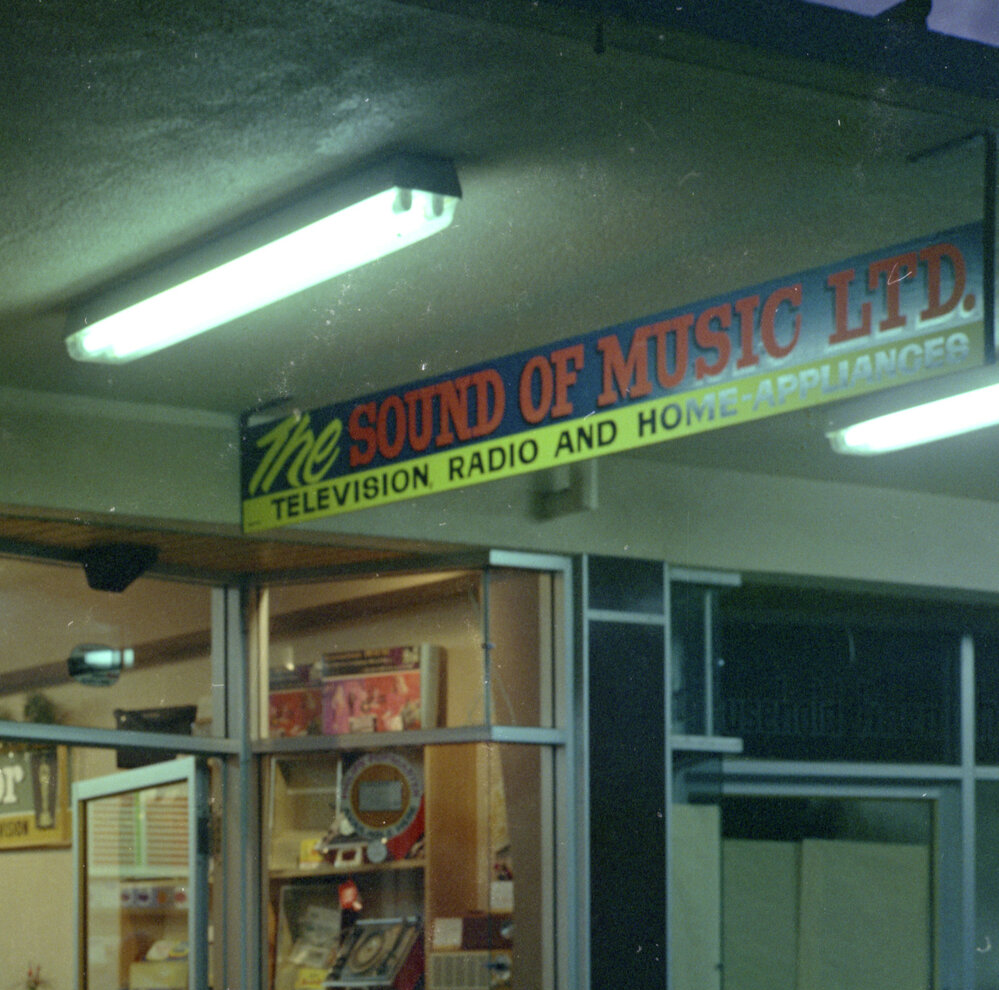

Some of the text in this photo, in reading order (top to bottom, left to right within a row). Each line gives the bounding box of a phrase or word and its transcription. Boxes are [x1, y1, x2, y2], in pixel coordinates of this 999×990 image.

[249, 242, 976, 495] The SOUND OF MUSIC LTD.
[449, 438, 538, 481] RADIO
[555, 419, 617, 458] AND
[638, 331, 971, 438] HOME-APPLIANCES
